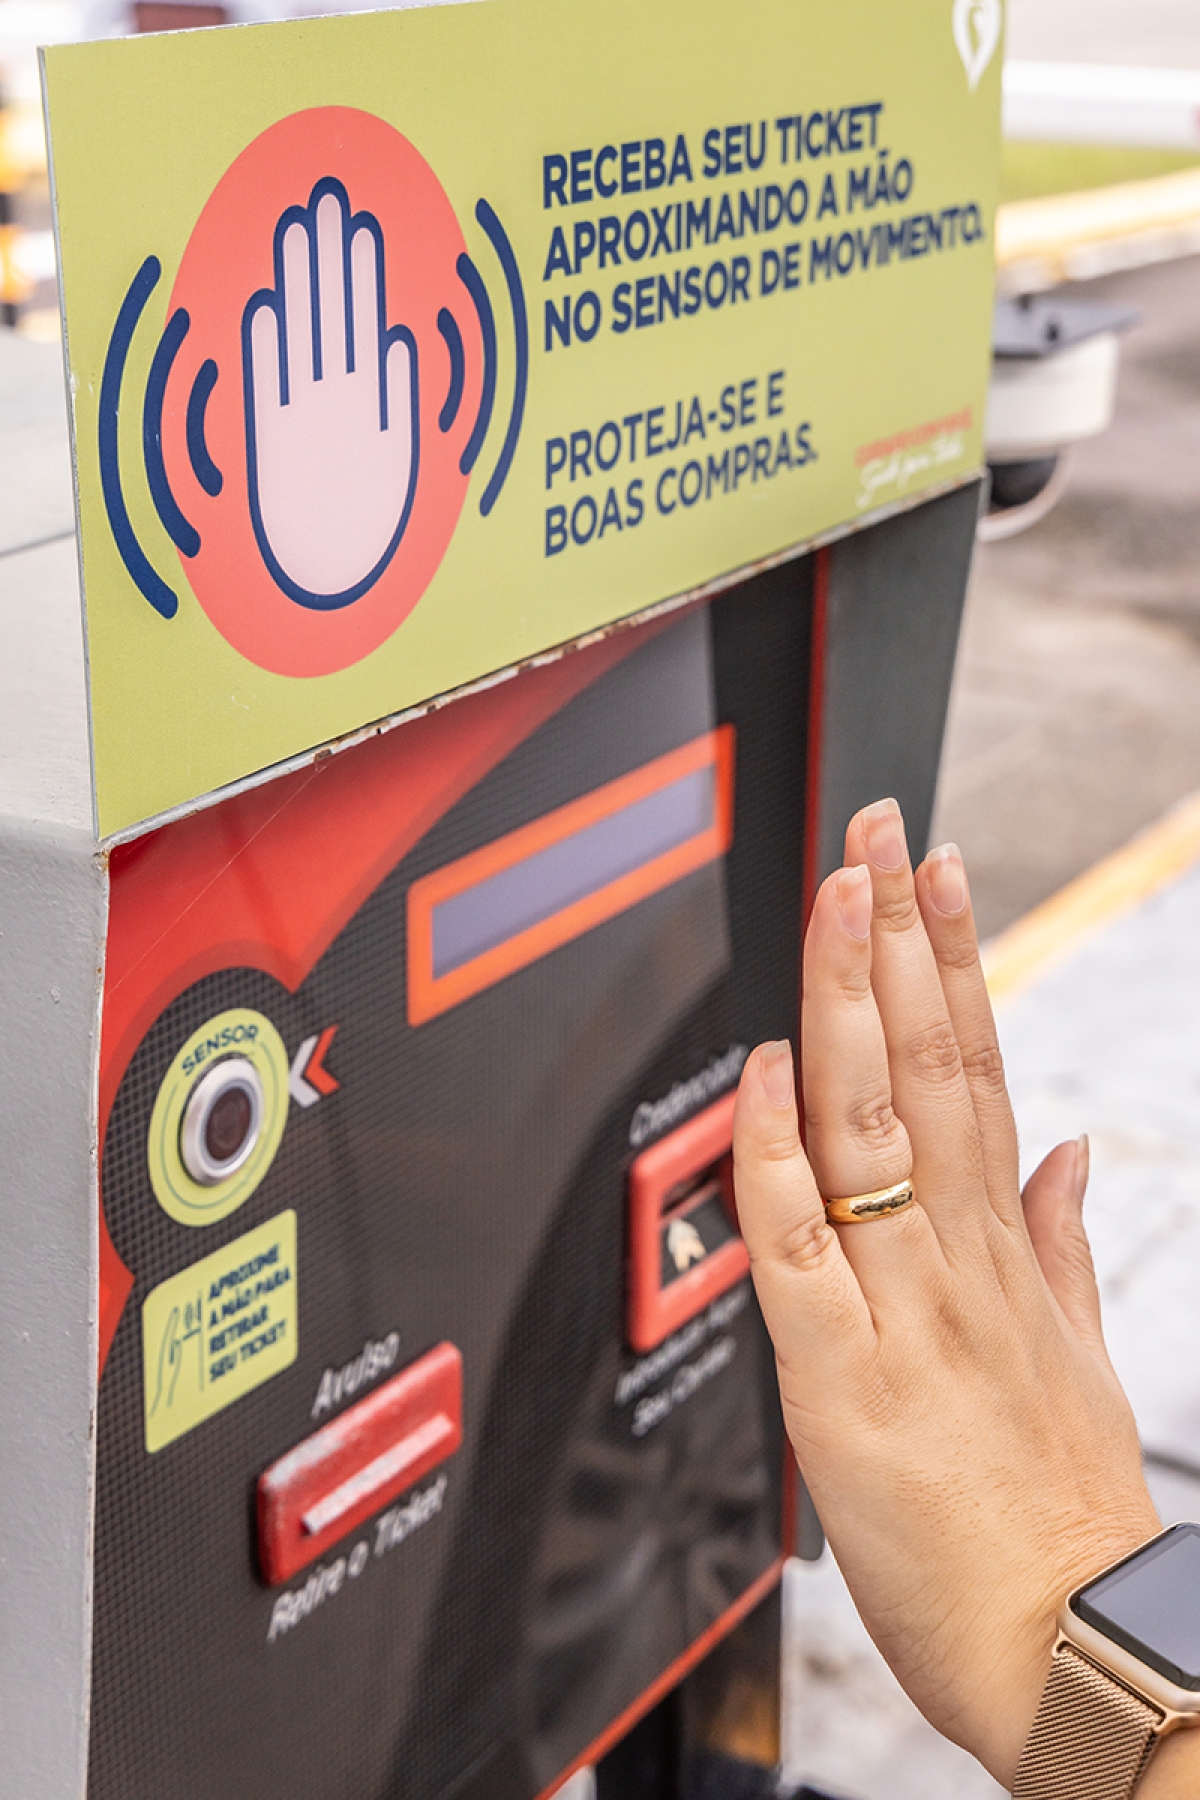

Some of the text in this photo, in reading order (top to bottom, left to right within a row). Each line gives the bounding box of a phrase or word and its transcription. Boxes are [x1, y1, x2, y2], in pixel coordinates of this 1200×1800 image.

[542, 102, 883, 210] RECEBA SEU TICKET
[542, 150, 913, 282] APROXIMANDO A MÃO
[543, 202, 986, 353] NO SENSOR DE MOVIMENTO.
[544, 370, 786, 491] PROTEJA-SE E
[544, 478, 645, 558] BOAS
[655, 423, 818, 515] COMPRAS.
[182, 1024, 259, 1076] SENSOR
[208, 1243, 280, 1301] APROXIME
[209, 1309, 218, 1329] A
[255, 1265, 291, 1299] PARA
[209, 1304, 269, 1354] RETIRAR
[209, 1318, 287, 1382] SEU TICKET
[267, 1473, 448, 1644] Retire o Ticket
